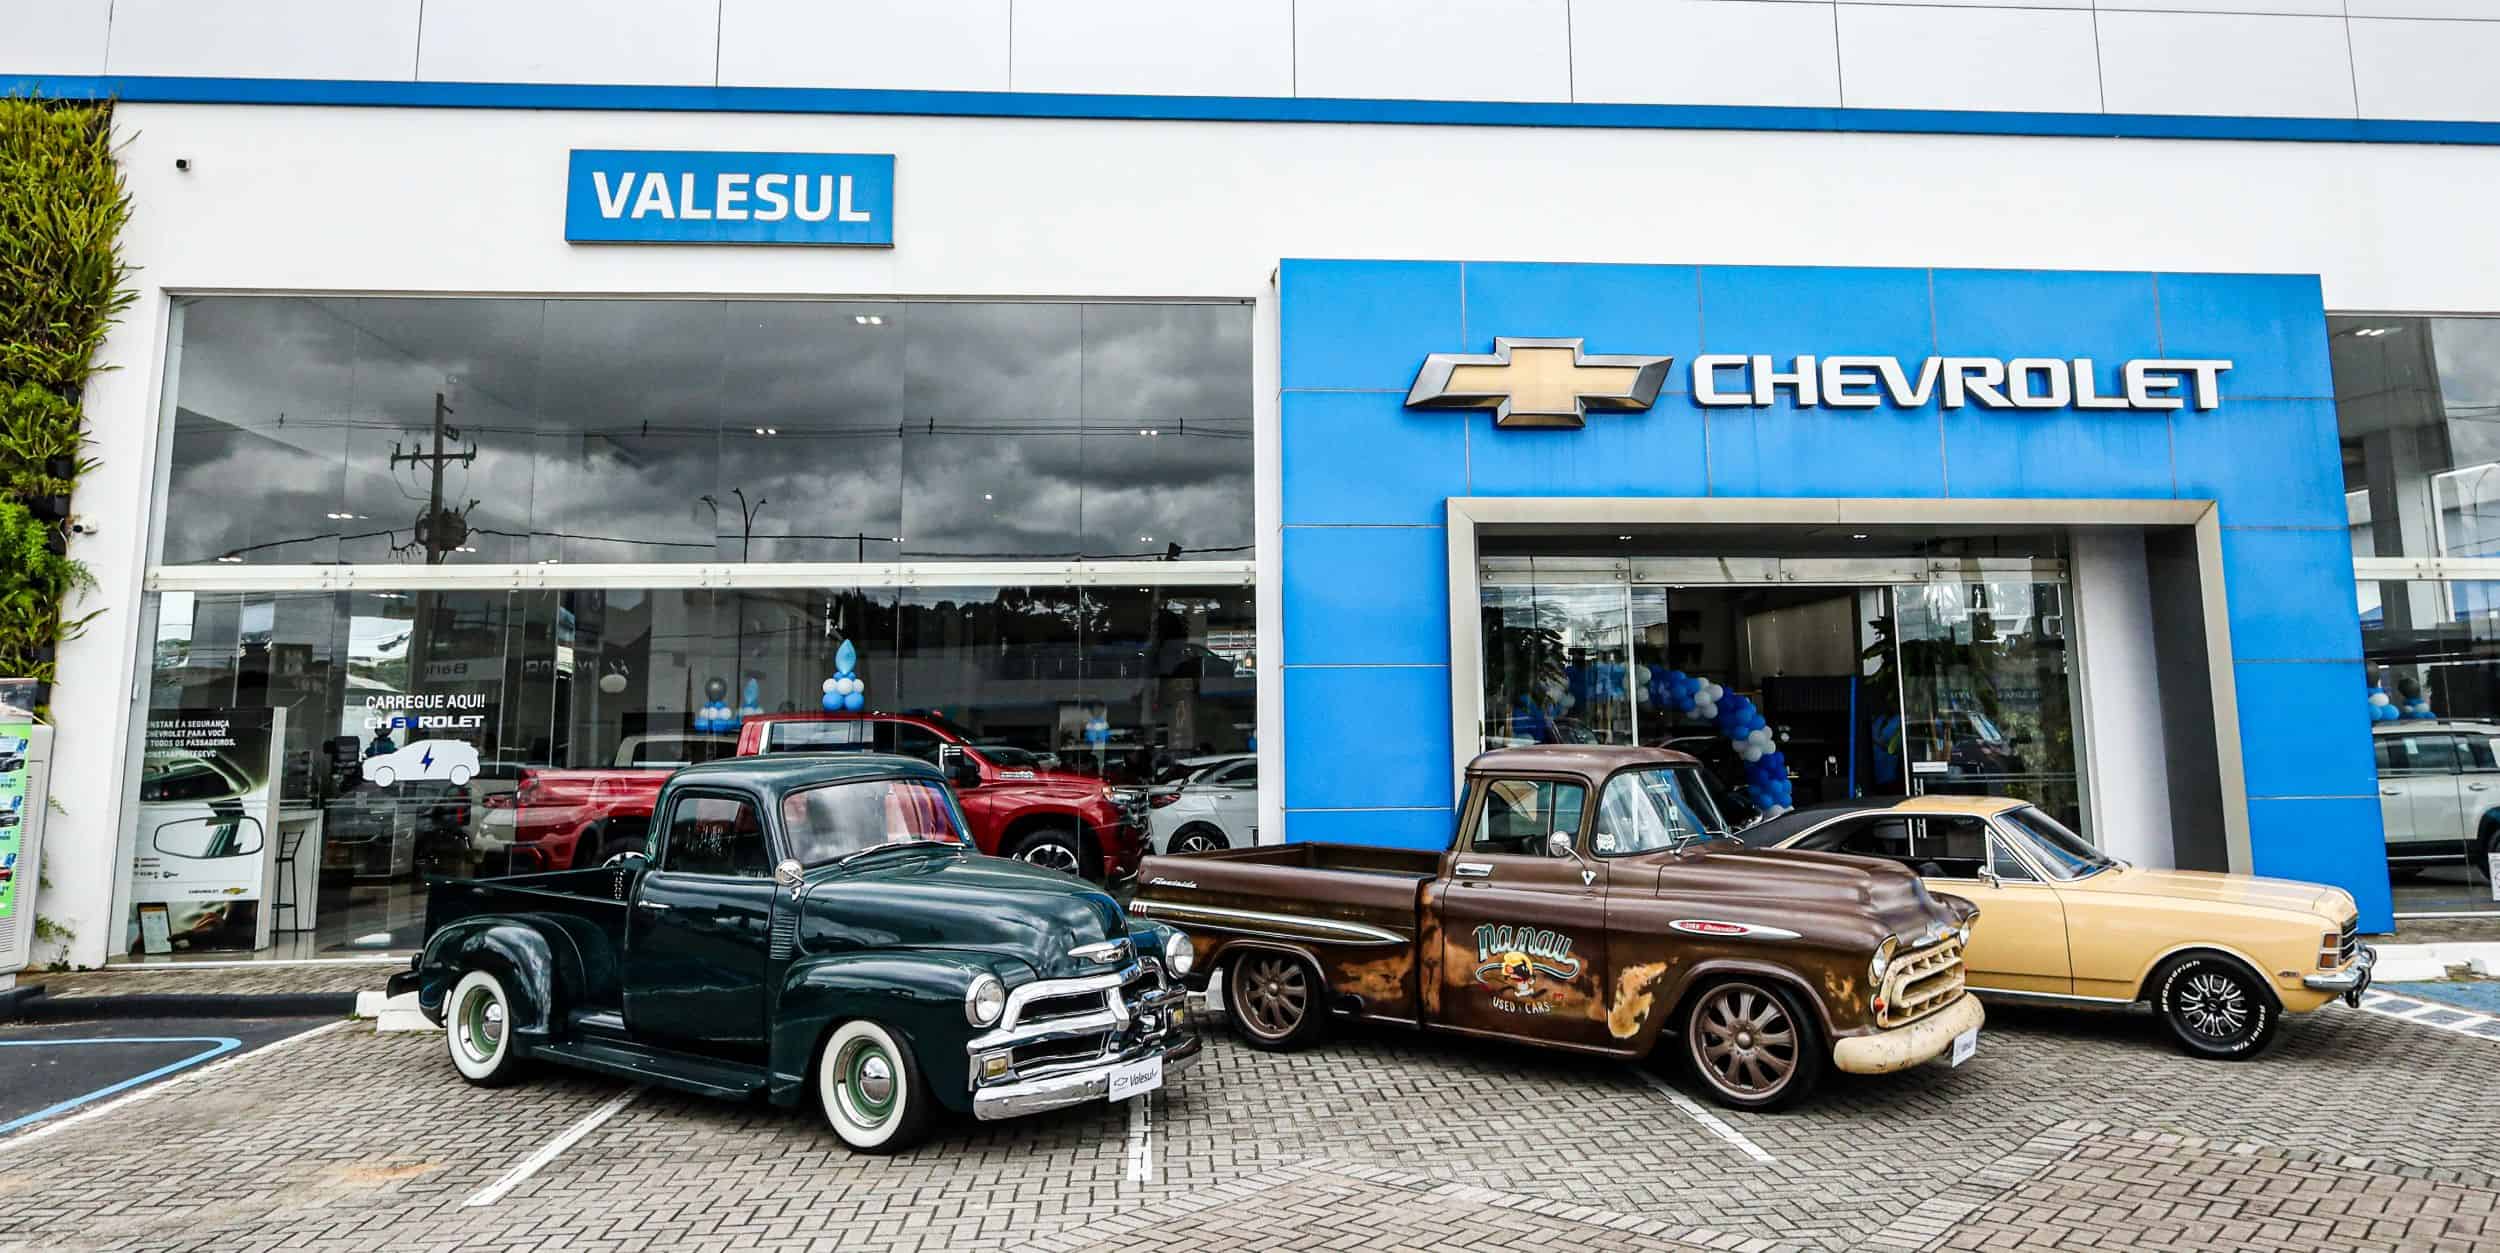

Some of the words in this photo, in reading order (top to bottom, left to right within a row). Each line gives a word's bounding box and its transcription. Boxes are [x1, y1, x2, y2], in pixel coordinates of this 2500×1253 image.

[592, 171, 871, 222] VALESUL
[1692, 353, 2233, 410] CHEVROLET
[366, 694, 444, 709] CARREGUE
[447, 693, 485, 709] AQUI!
[364, 715, 484, 729] CHEVROLET
[1492, 996, 1516, 1013] USED
[1525, 1001, 1552, 1014] CARS
